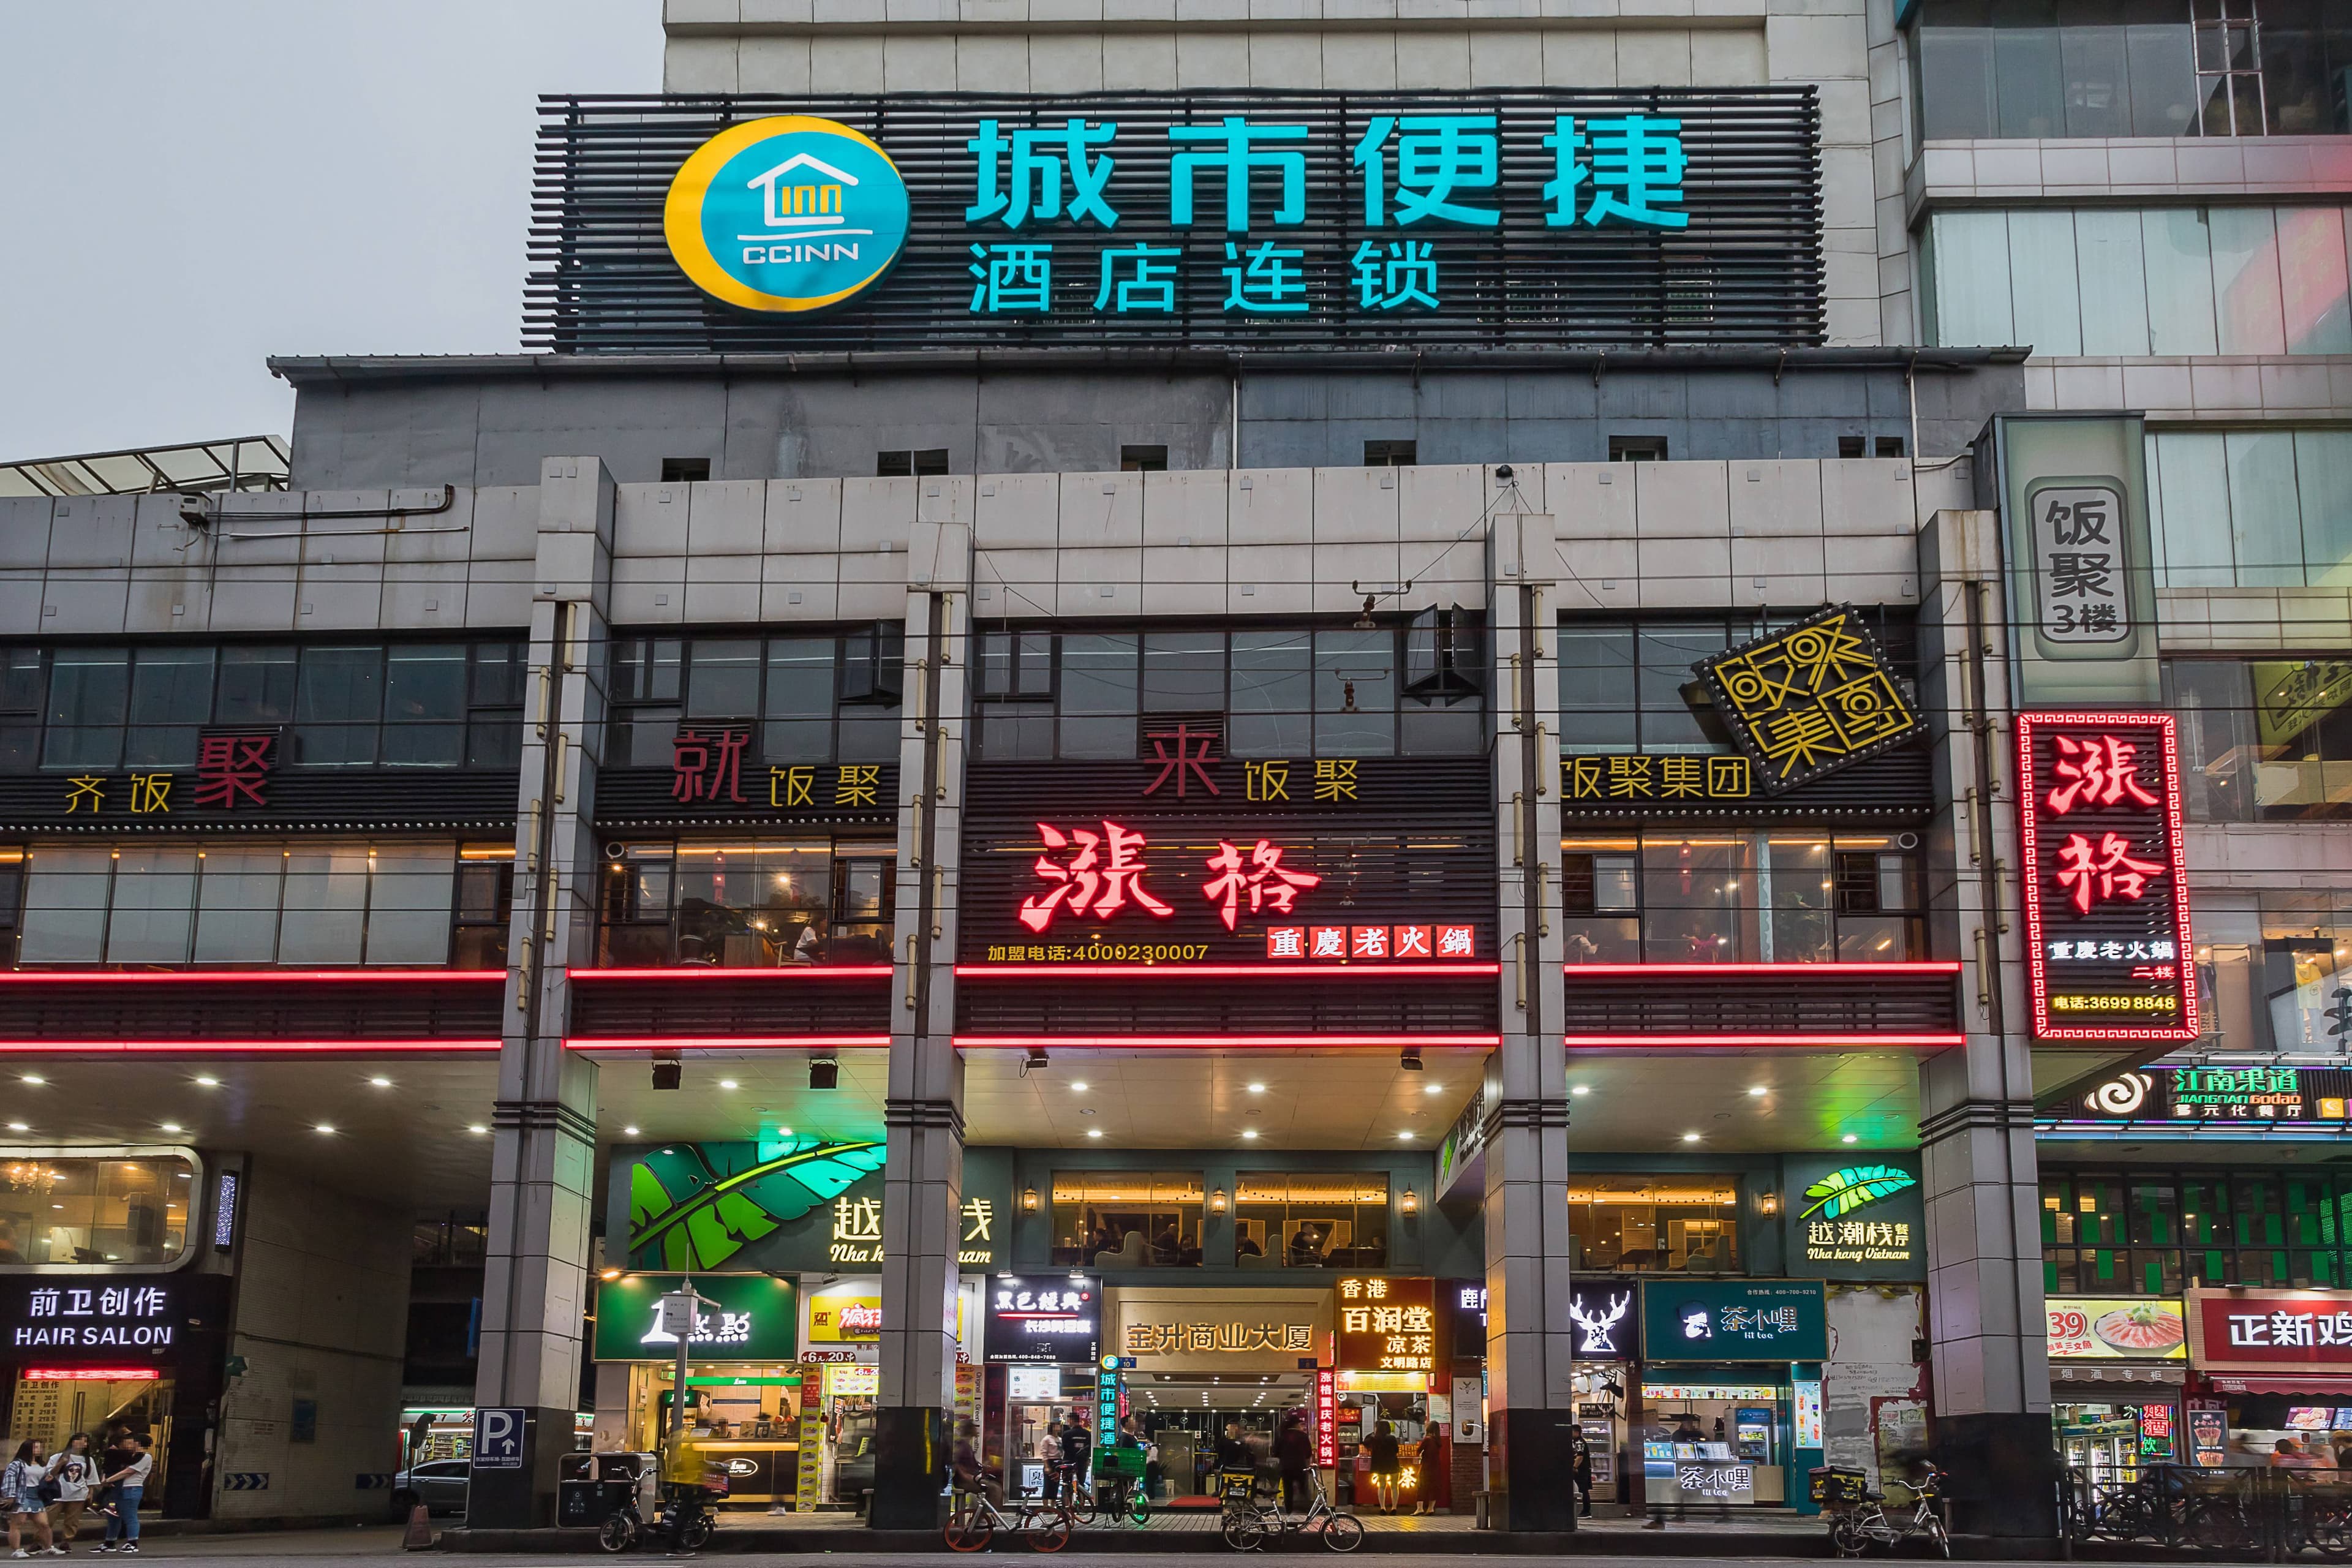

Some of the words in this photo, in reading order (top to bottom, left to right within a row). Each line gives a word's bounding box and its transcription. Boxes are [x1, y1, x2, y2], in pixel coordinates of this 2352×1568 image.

[966, 115, 1691, 230] 城市便捷
[743, 243, 859, 264] CCINN
[967, 241, 1442, 313] 酒店连锁
[2046, 500, 2114, 598] 饭聚
[2052, 604, 2117, 634] 3楼
[1561, 756, 1751, 798] 饭聚集团
[1268, 926, 1473, 958] 重慶老火鍋
[2048, 941, 2174, 960] 重慶老火鍋
[2132, 966, 2175, 978] 二楼
[2176, 1069, 2299, 1092] 江南果道
[2176, 1105, 2302, 1117] 多元化餐厅
[1808, 1221, 1893, 1246] 越潮栈
[1894, 1223, 1909, 1246] 餐厅
[1807, 1248, 1832, 1259] Nha
[1833, 1248, 1863, 1262] hang
[1865, 1247, 1910, 1259] Vietnam
[30, 1287, 167, 1317] 前卫创作
[1341, 1279, 1387, 1298] 香港
[1341, 1306, 1433, 1333] 百润堂
[2049, 1311, 2087, 1340] 39
[2228, 1310, 2352, 1346] 正新鸡
[15, 1327, 76, 1345] HAIR
[82, 1327, 172, 1345] SALON
[1126, 1322, 1313, 1351] 宝升商业大厦
[1387, 1335, 1431, 1354] 凉茶
[1380, 1357, 1432, 1368] 文明路店
[2061, 1368, 2162, 1380] 烟酒专柜
[1100, 1373, 1117, 1449] 城市便捷酒
[1321, 1372, 1332, 1457] 涨格重庆老火锅
[2143, 1405, 2169, 1436] 烟酒
[481, 1411, 513, 1454] P
[1681, 1466, 1751, 1490] 茶小嘿
